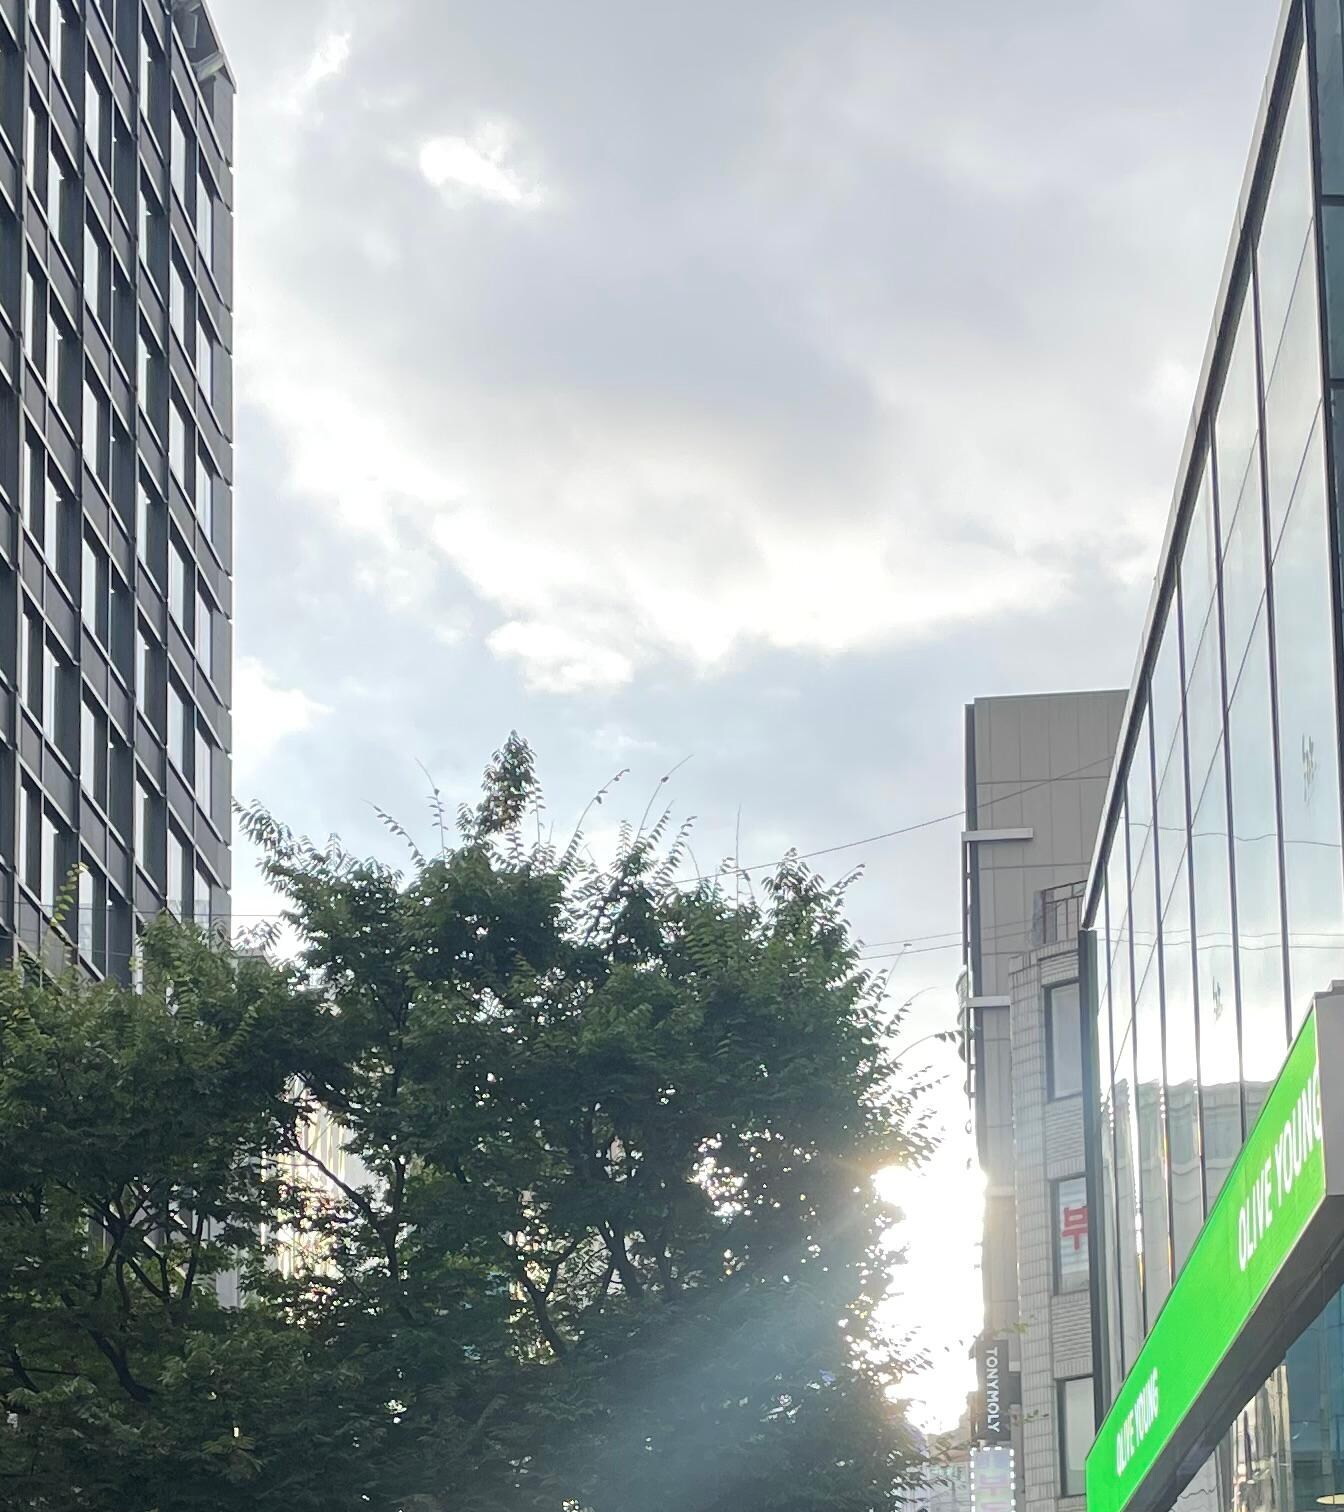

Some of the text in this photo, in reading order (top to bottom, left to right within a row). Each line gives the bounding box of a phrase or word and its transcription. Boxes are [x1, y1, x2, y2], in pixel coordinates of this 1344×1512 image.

[1237, 1071, 1322, 1273] OLIVE YOUNG
[984, 1346, 999, 1433] TONYMOLY
